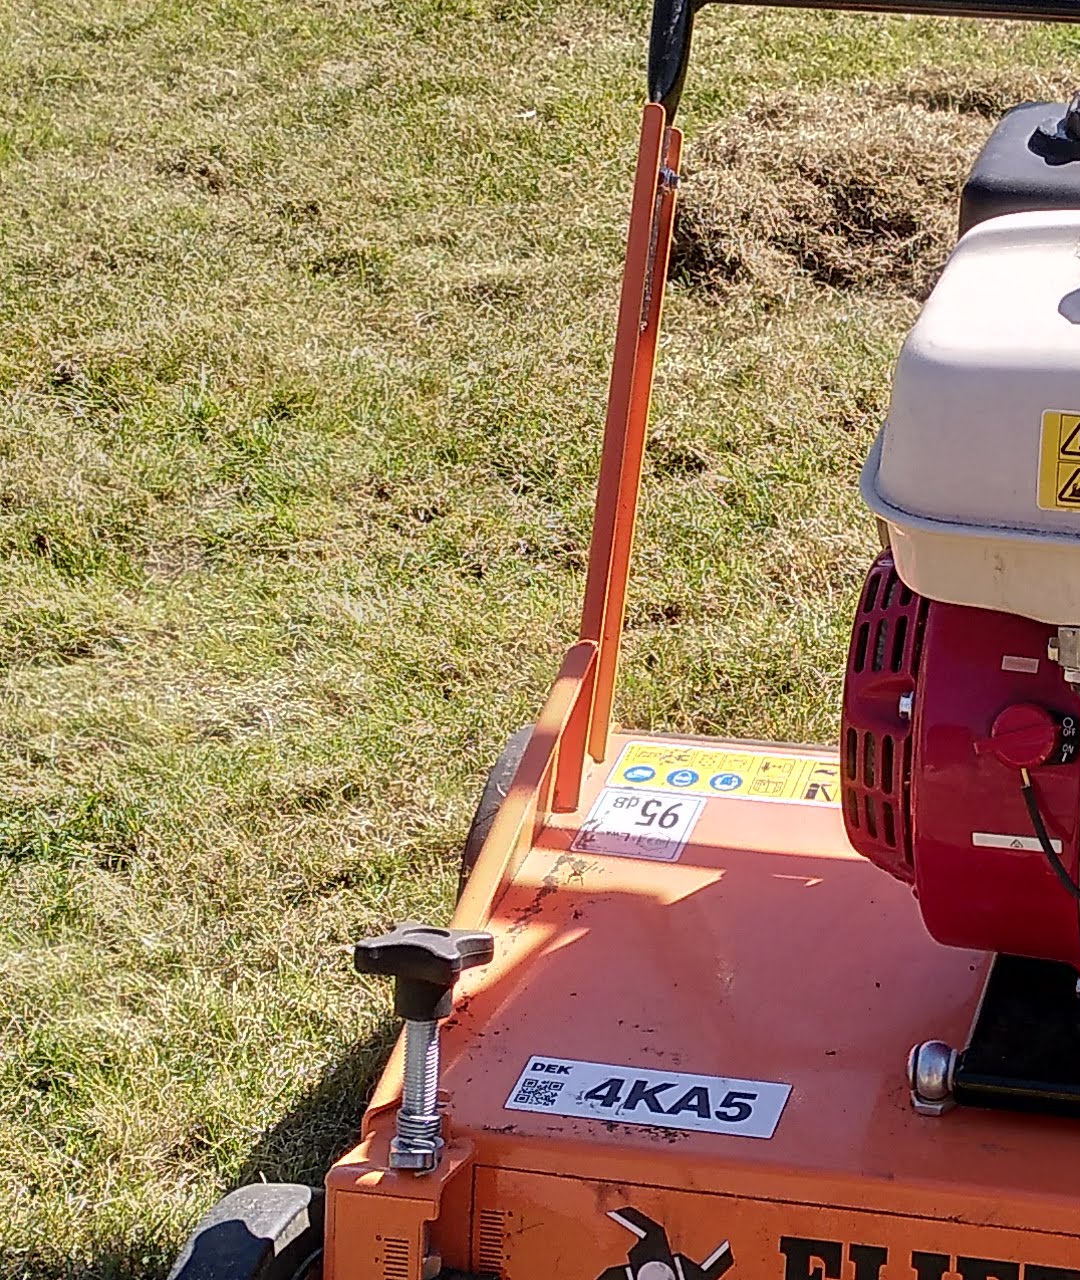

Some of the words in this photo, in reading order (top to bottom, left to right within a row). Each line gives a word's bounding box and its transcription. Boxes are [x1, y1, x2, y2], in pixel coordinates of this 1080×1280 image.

[1063, 728, 1076, 736] OFF
[1062, 744, 1074, 754] ON
[612, 796, 640, 809] dB
[634, 799, 683, 829] 95
[530, 1062, 574, 1075] DEK
[584, 1078, 758, 1122] 4KA5
